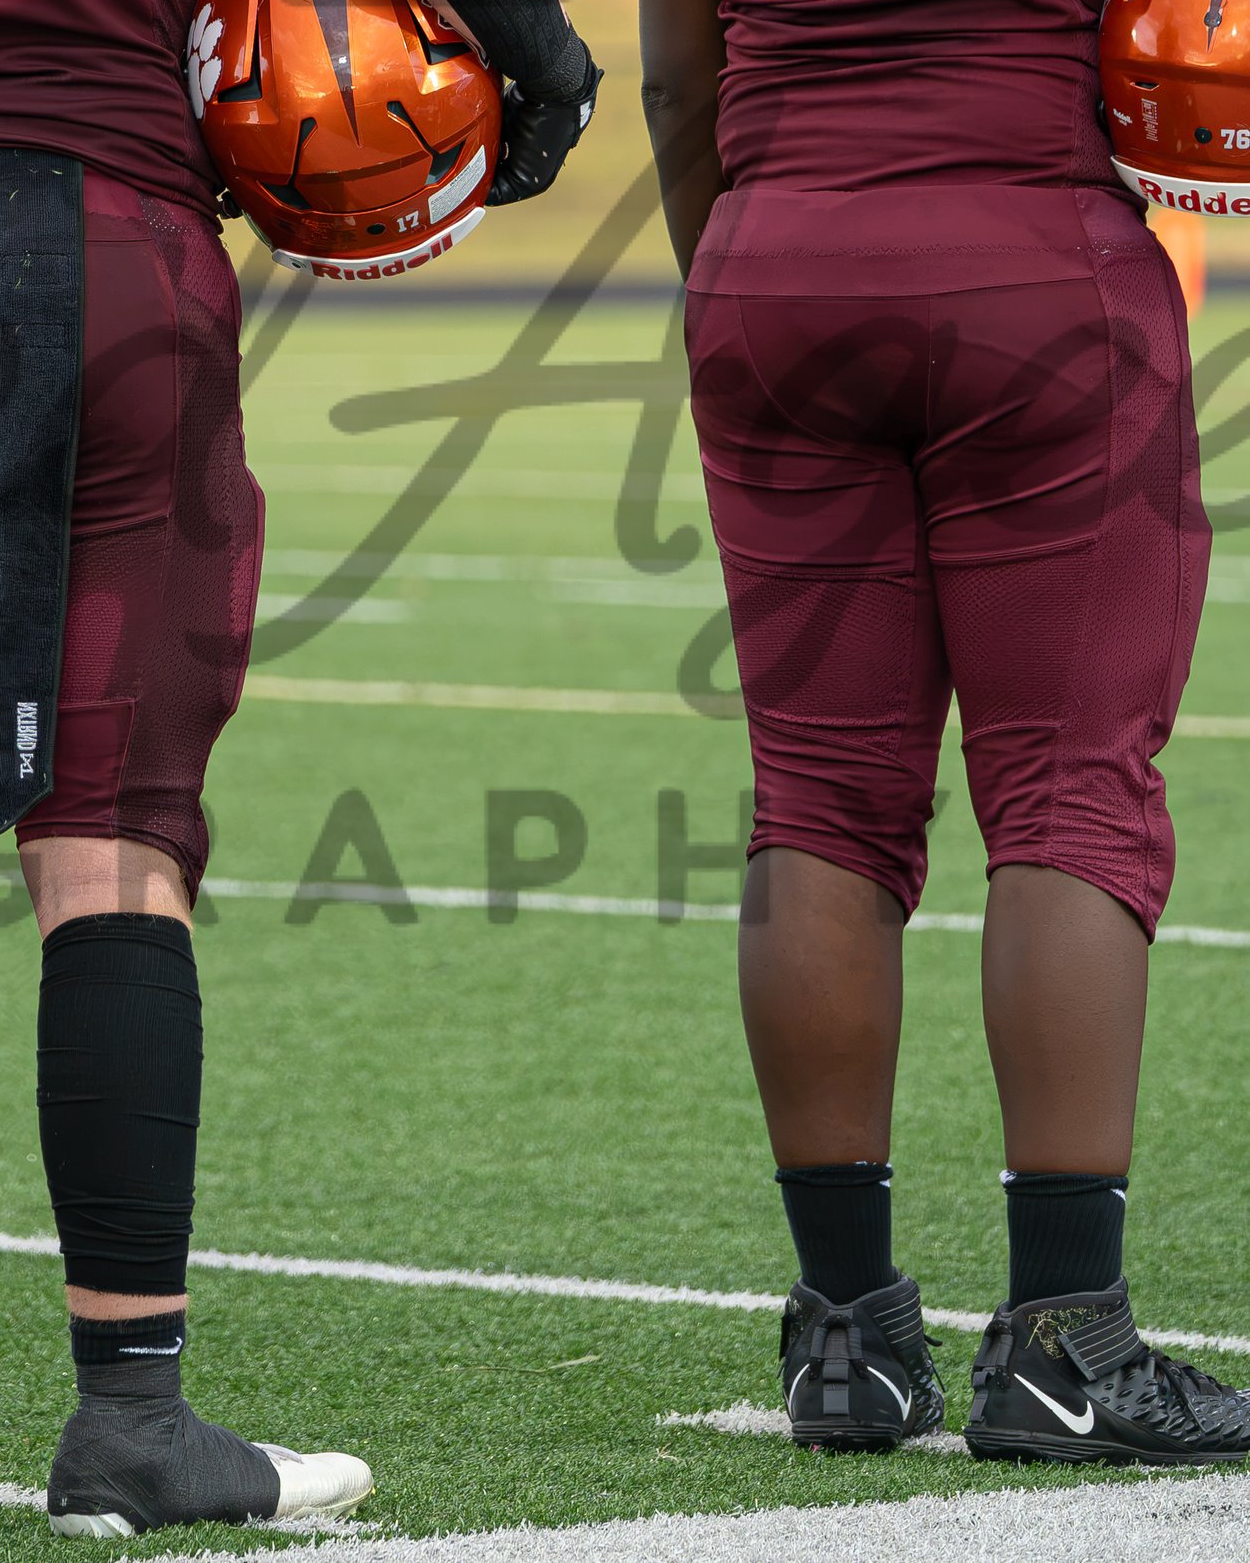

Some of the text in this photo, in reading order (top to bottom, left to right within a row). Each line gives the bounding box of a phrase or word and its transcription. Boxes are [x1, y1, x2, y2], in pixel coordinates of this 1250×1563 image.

[1220, 129, 1250, 149] 76
[396, 210, 419, 233] 17
[311, 232, 454, 280] Riddell
